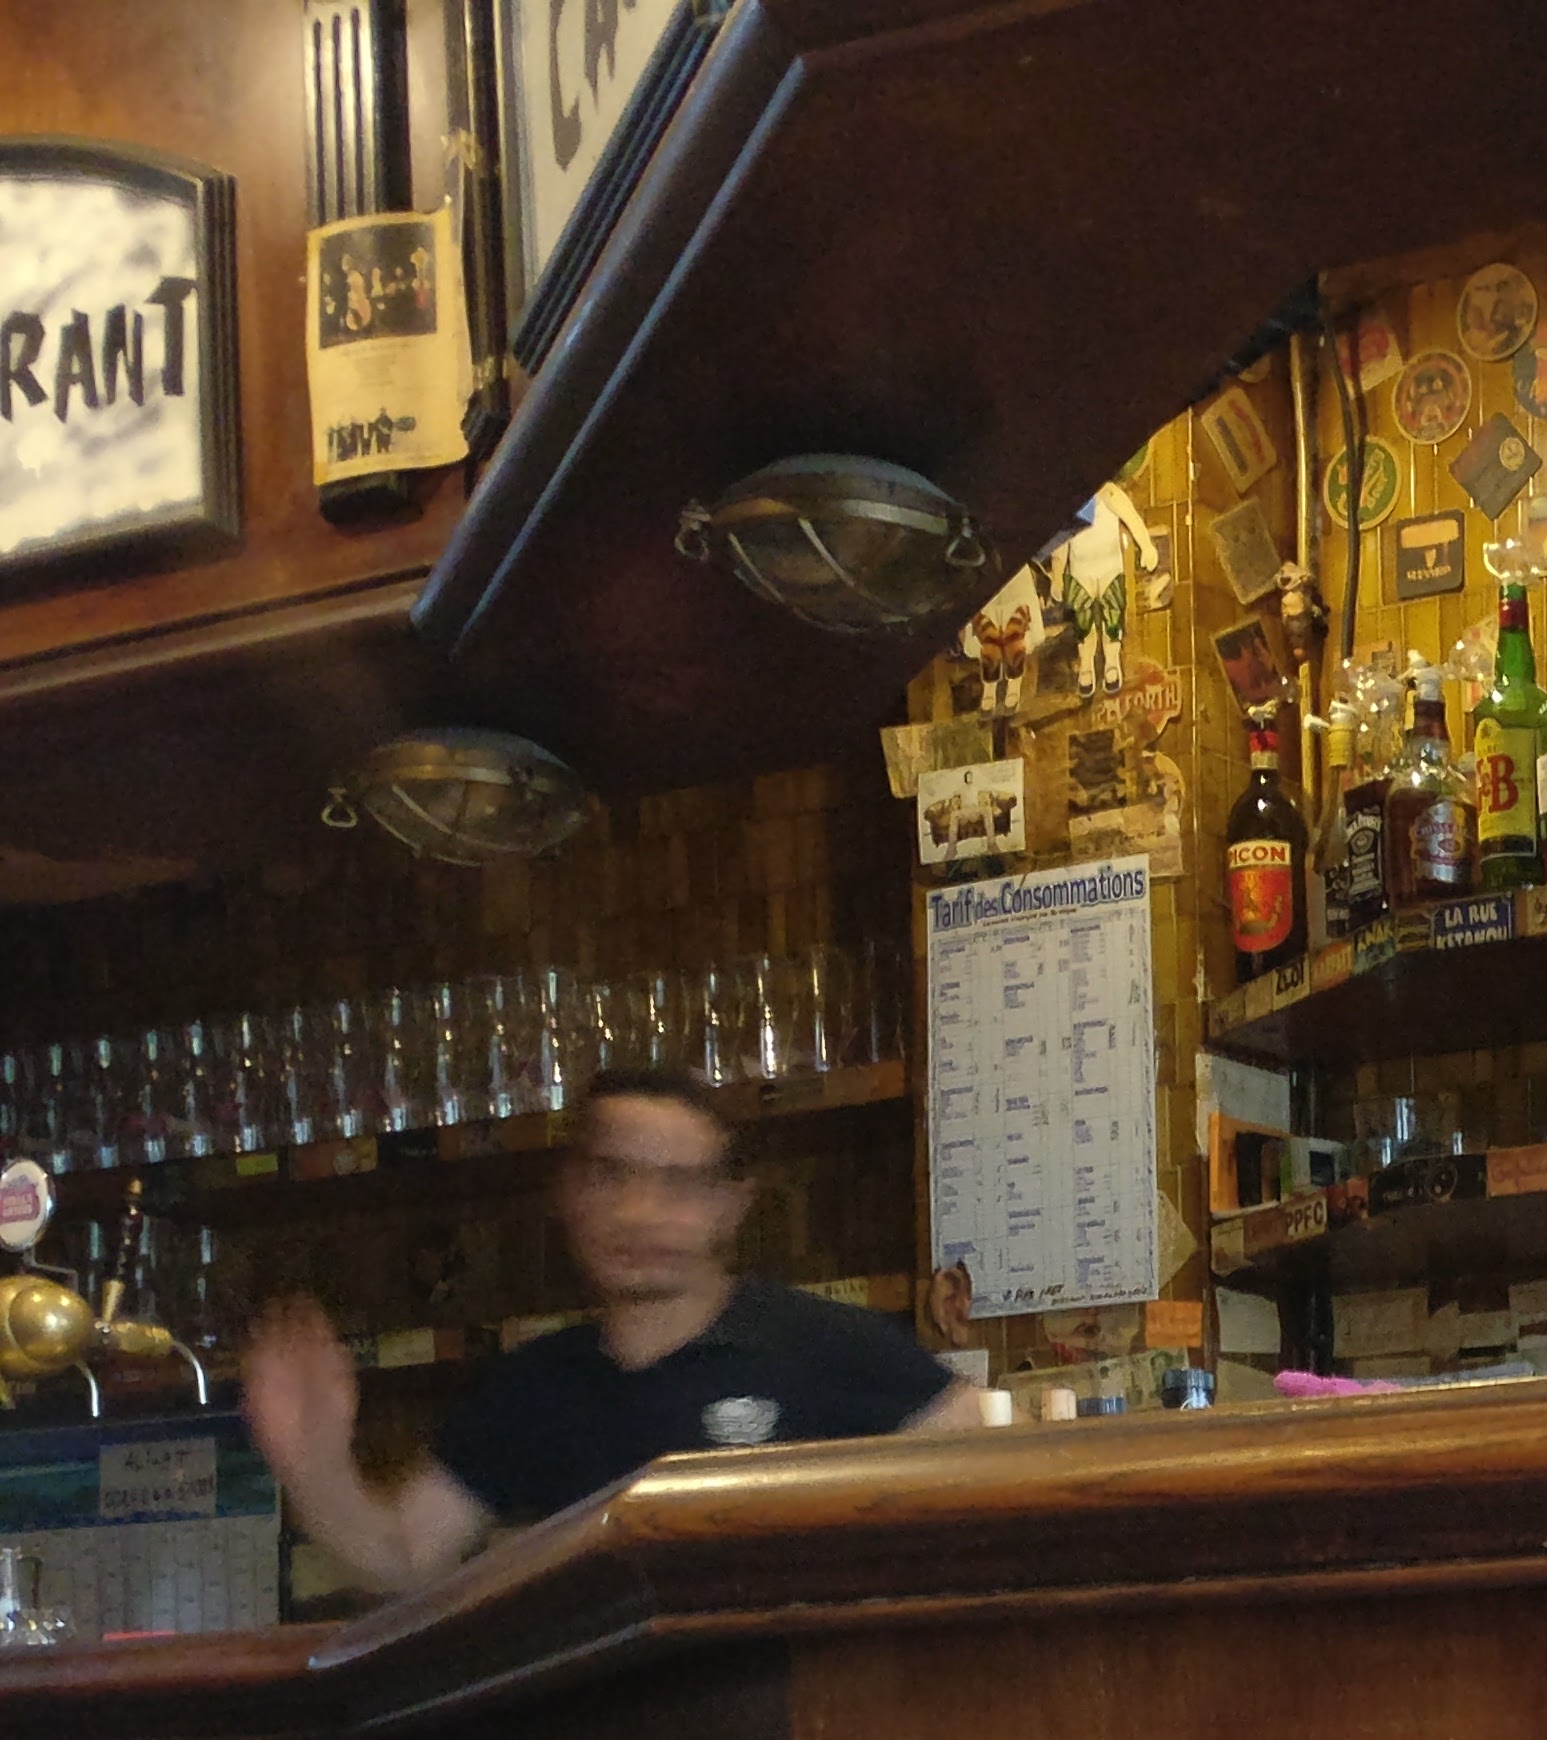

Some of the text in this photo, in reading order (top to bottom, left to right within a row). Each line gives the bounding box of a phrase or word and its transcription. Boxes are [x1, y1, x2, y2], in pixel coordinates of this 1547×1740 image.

[931, 888, 974, 928] Tarif
[975, 892, 998, 919] des
[1000, 866, 1145, 914] Consommations
[1444, 900, 1498, 928] LA RUE
